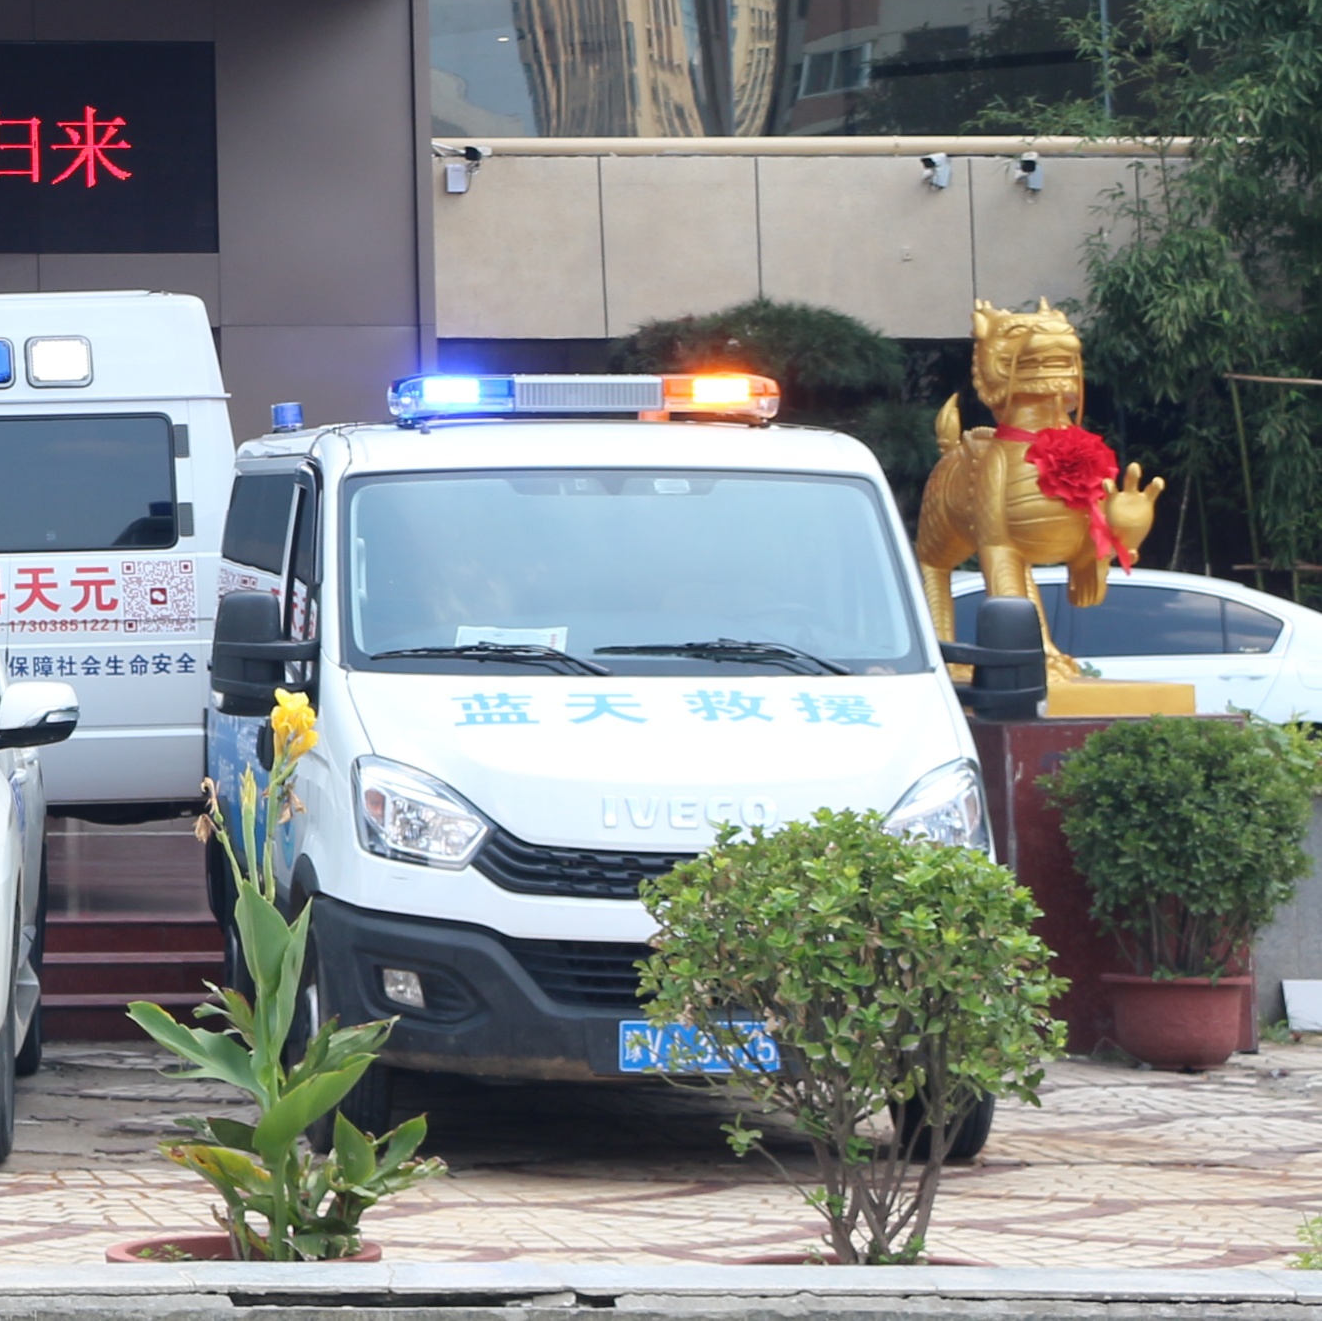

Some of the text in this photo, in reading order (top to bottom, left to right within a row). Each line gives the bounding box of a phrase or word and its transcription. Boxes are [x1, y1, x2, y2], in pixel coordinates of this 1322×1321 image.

[8, 652, 197, 678] 保障社会生命安全
[452, 688, 884, 730] 蓝天救援
[602, 793, 778, 830] IVECO
